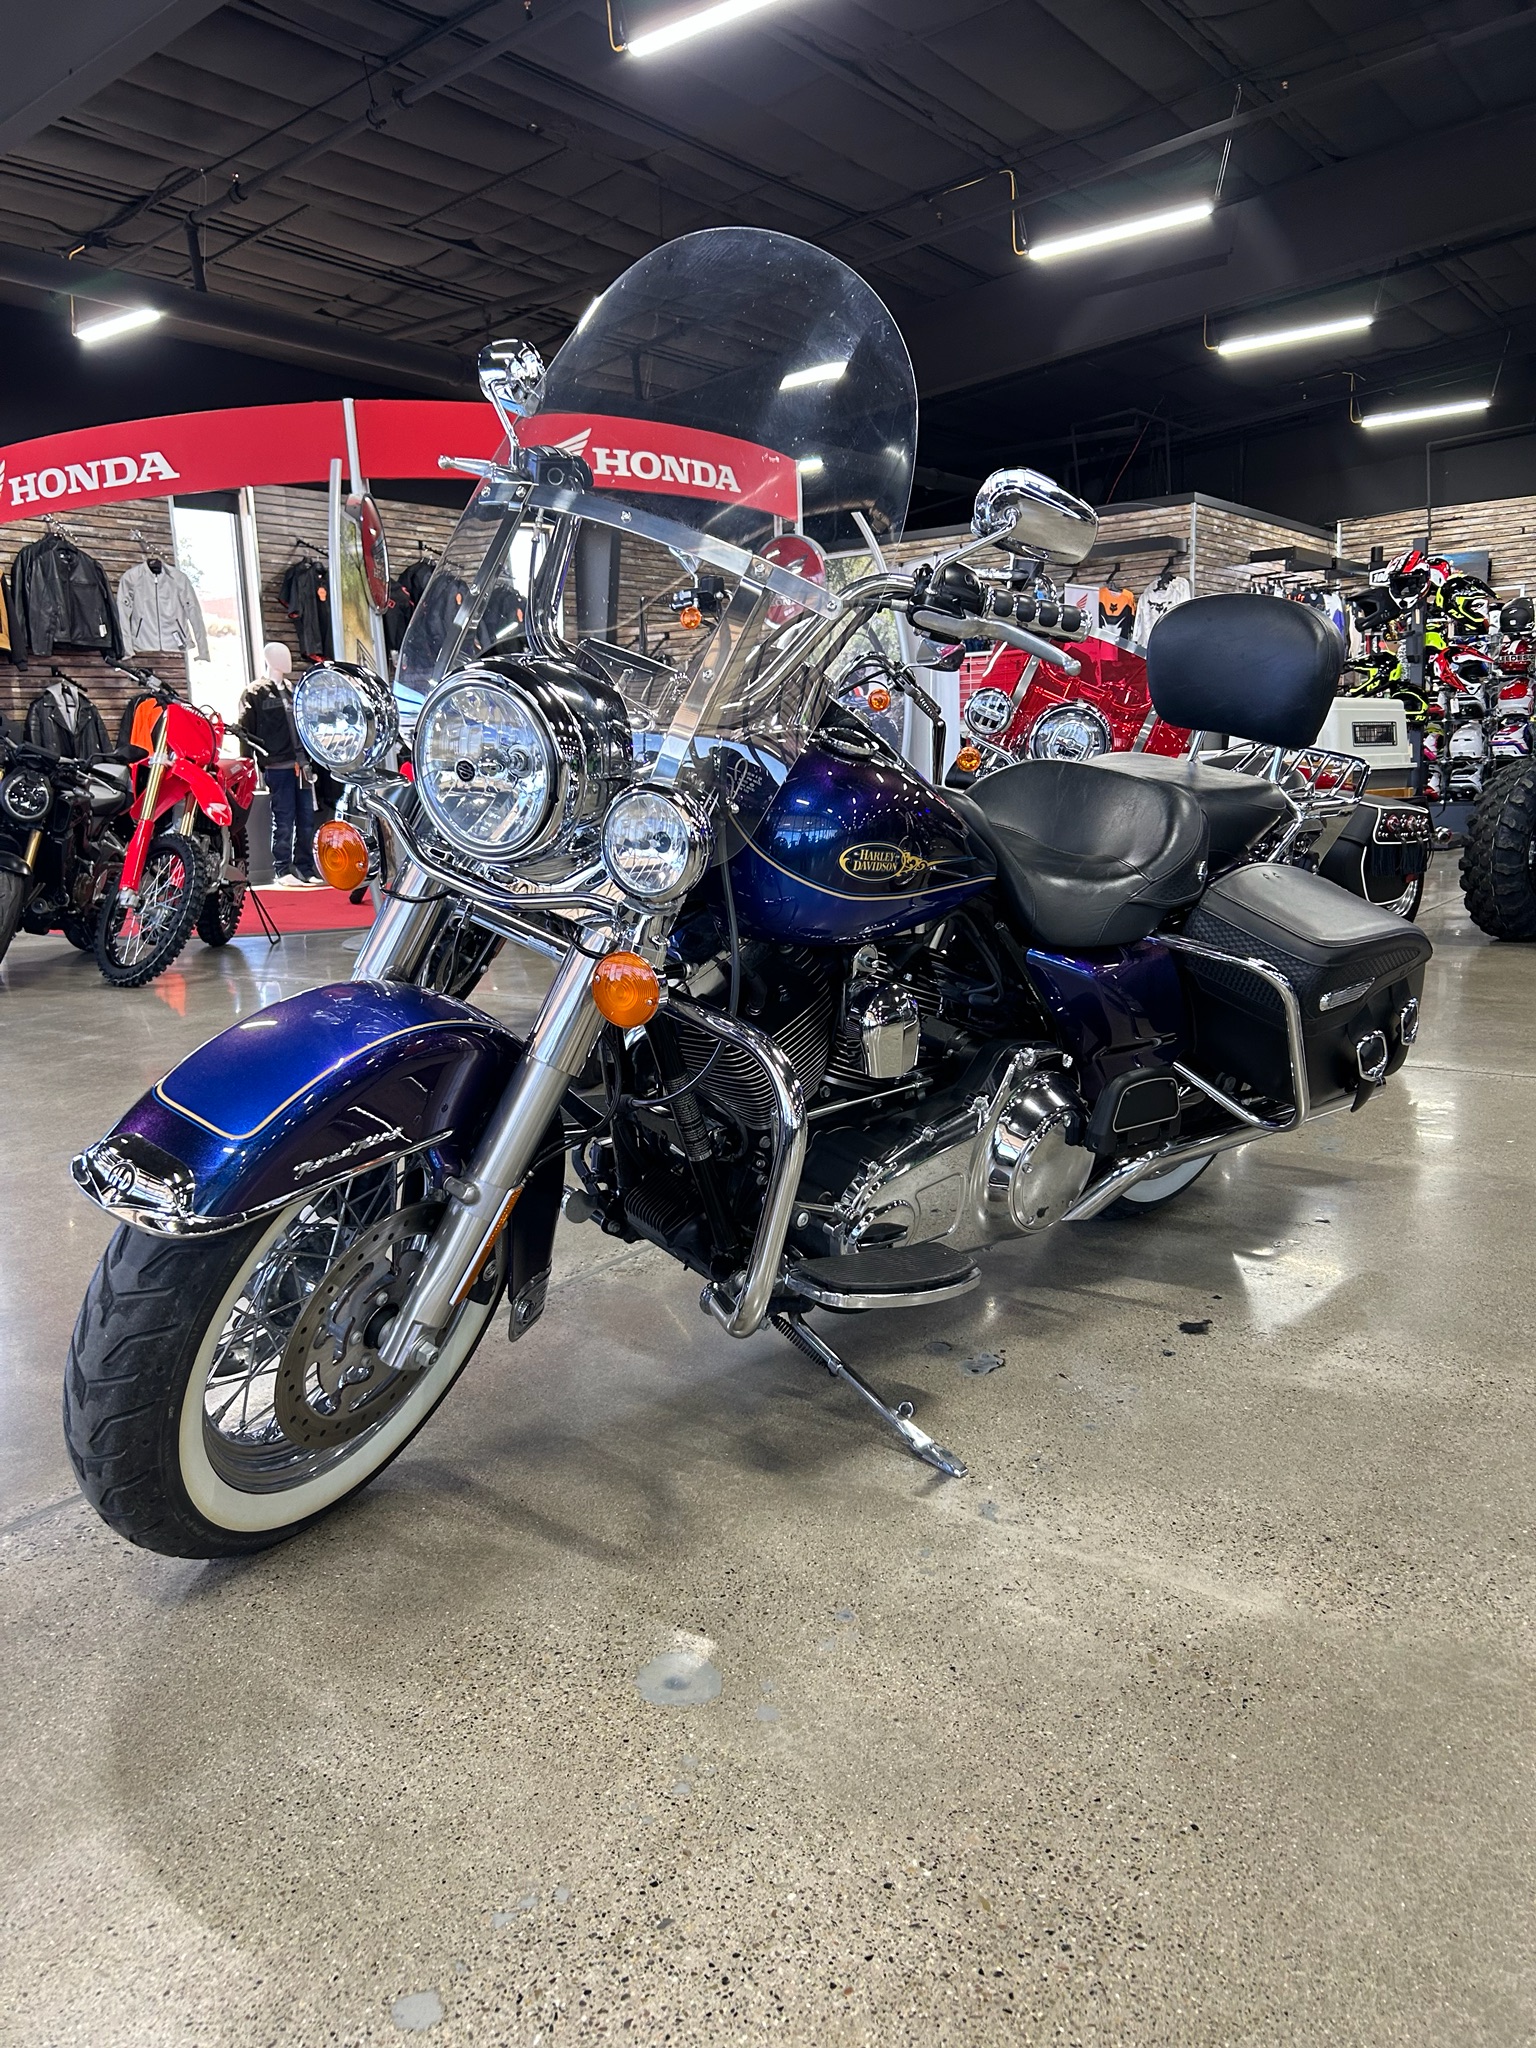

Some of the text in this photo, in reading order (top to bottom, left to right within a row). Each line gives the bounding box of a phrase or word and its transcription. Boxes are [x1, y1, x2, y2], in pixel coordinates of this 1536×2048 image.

[8, 451, 180, 506] HONDA
[592, 447, 741, 493] HONDA
[853, 860, 898, 871] DAVIDSON
